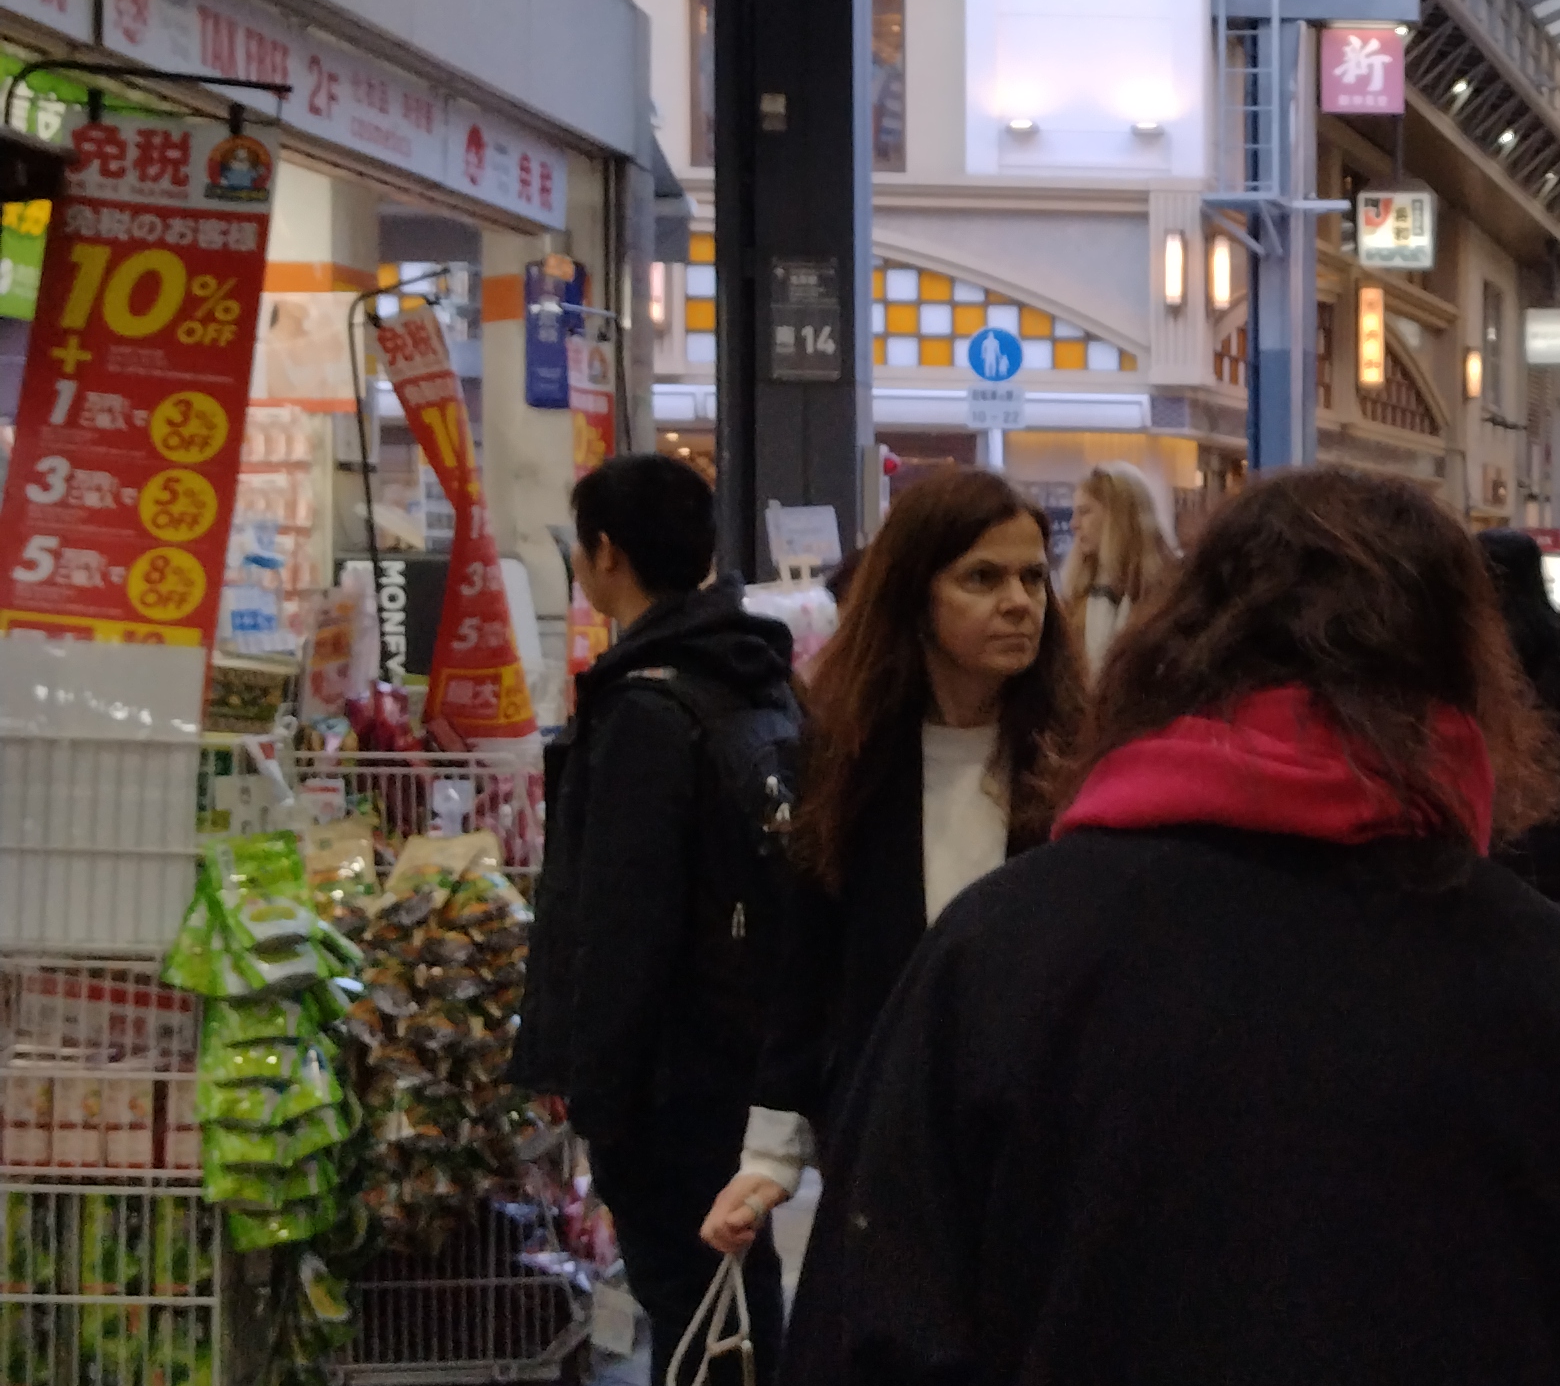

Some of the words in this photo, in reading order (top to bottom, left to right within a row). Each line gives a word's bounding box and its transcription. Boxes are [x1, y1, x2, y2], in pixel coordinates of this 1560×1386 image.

[1333, 34, 1393, 92] 新
[66, 123, 192, 188] 免税
[177, 320, 239, 348] OFF
[801, 324, 836, 355] 14
[49, 379, 78, 425] 1
[25, 455, 71, 505] 3
[11, 534, 60, 582] 5
